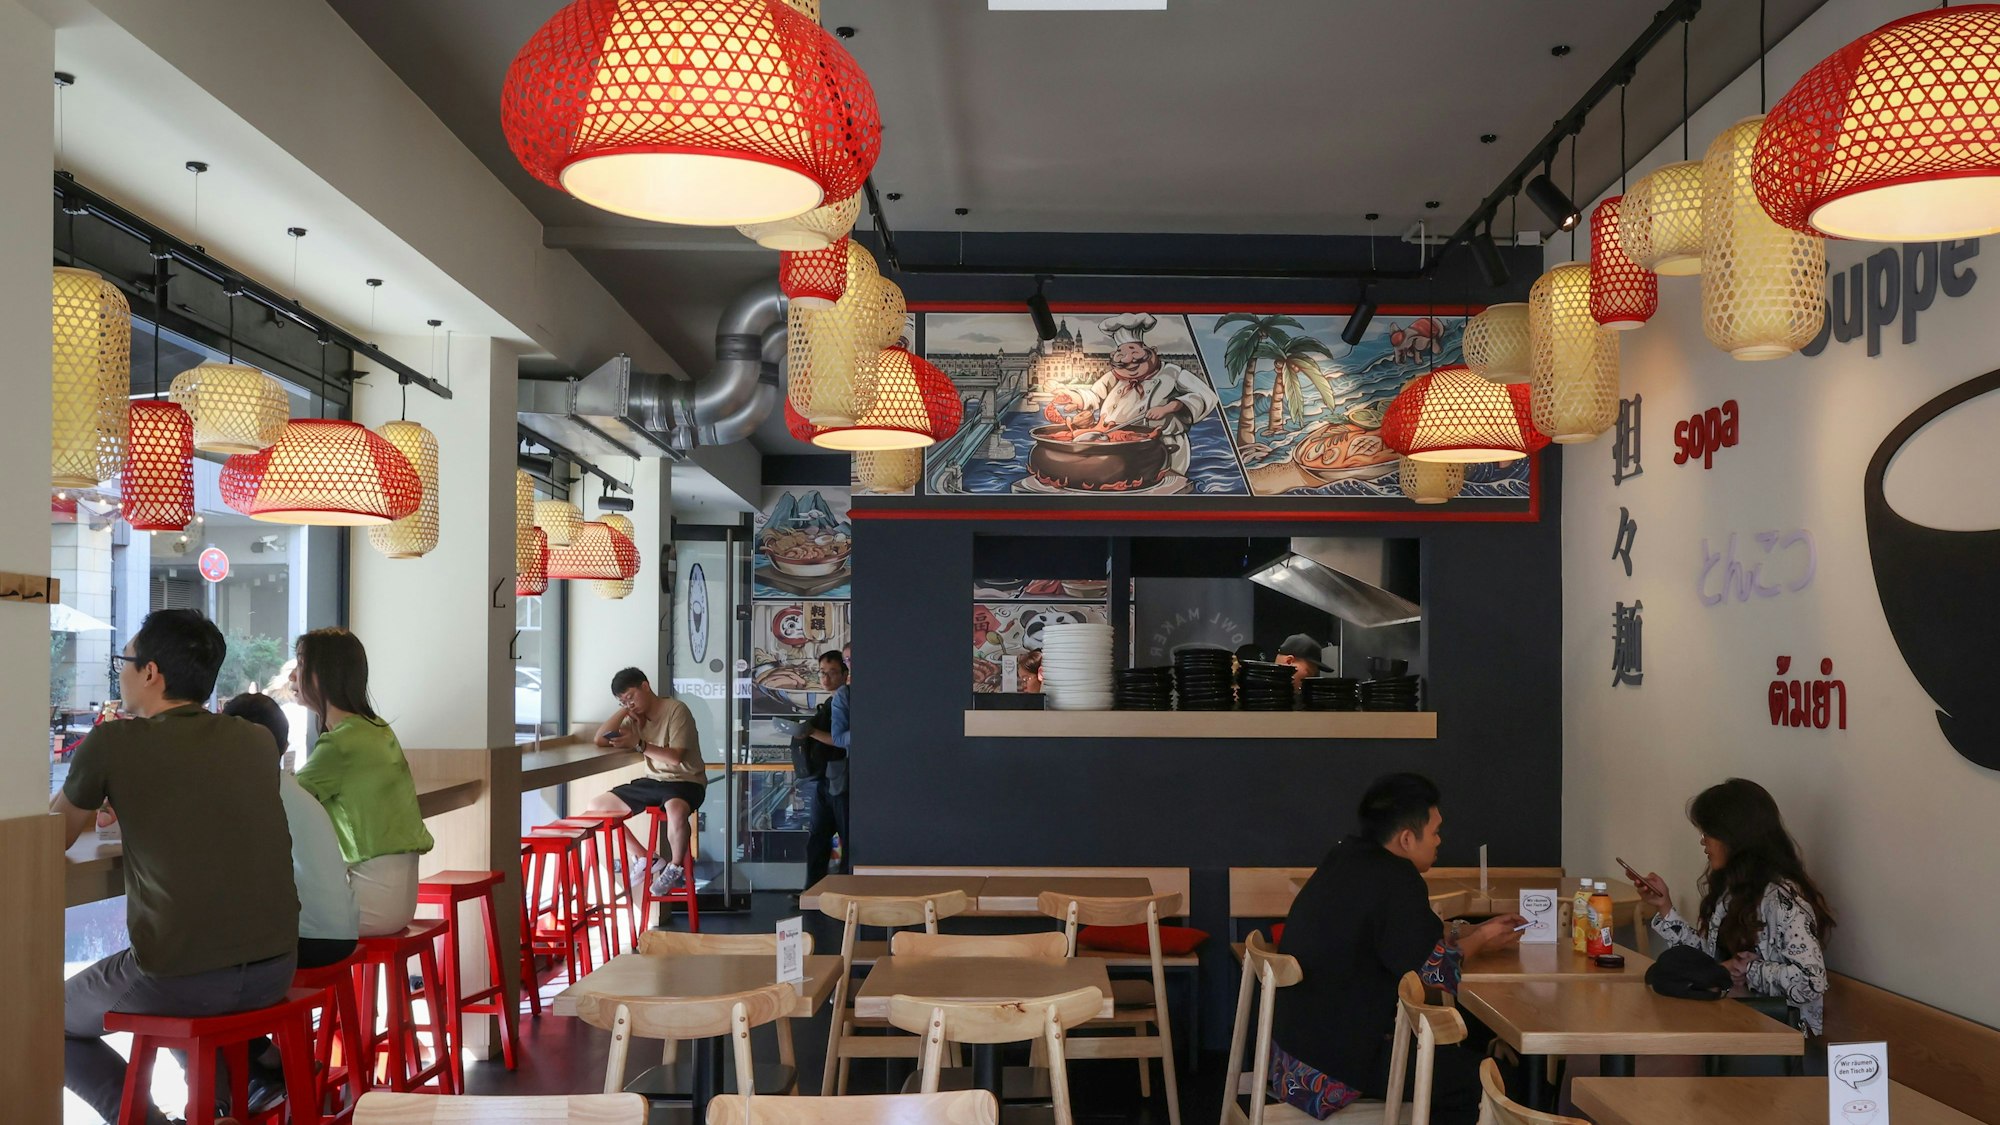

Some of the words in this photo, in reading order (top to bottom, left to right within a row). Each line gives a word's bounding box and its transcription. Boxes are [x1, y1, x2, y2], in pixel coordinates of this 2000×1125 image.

[1673, 399, 1739, 469] sopa
[1698, 529, 1817, 607] とんこつ
[810, 605, 826, 630] 料理
[1768, 655, 1846, 730] ต้มยำ
